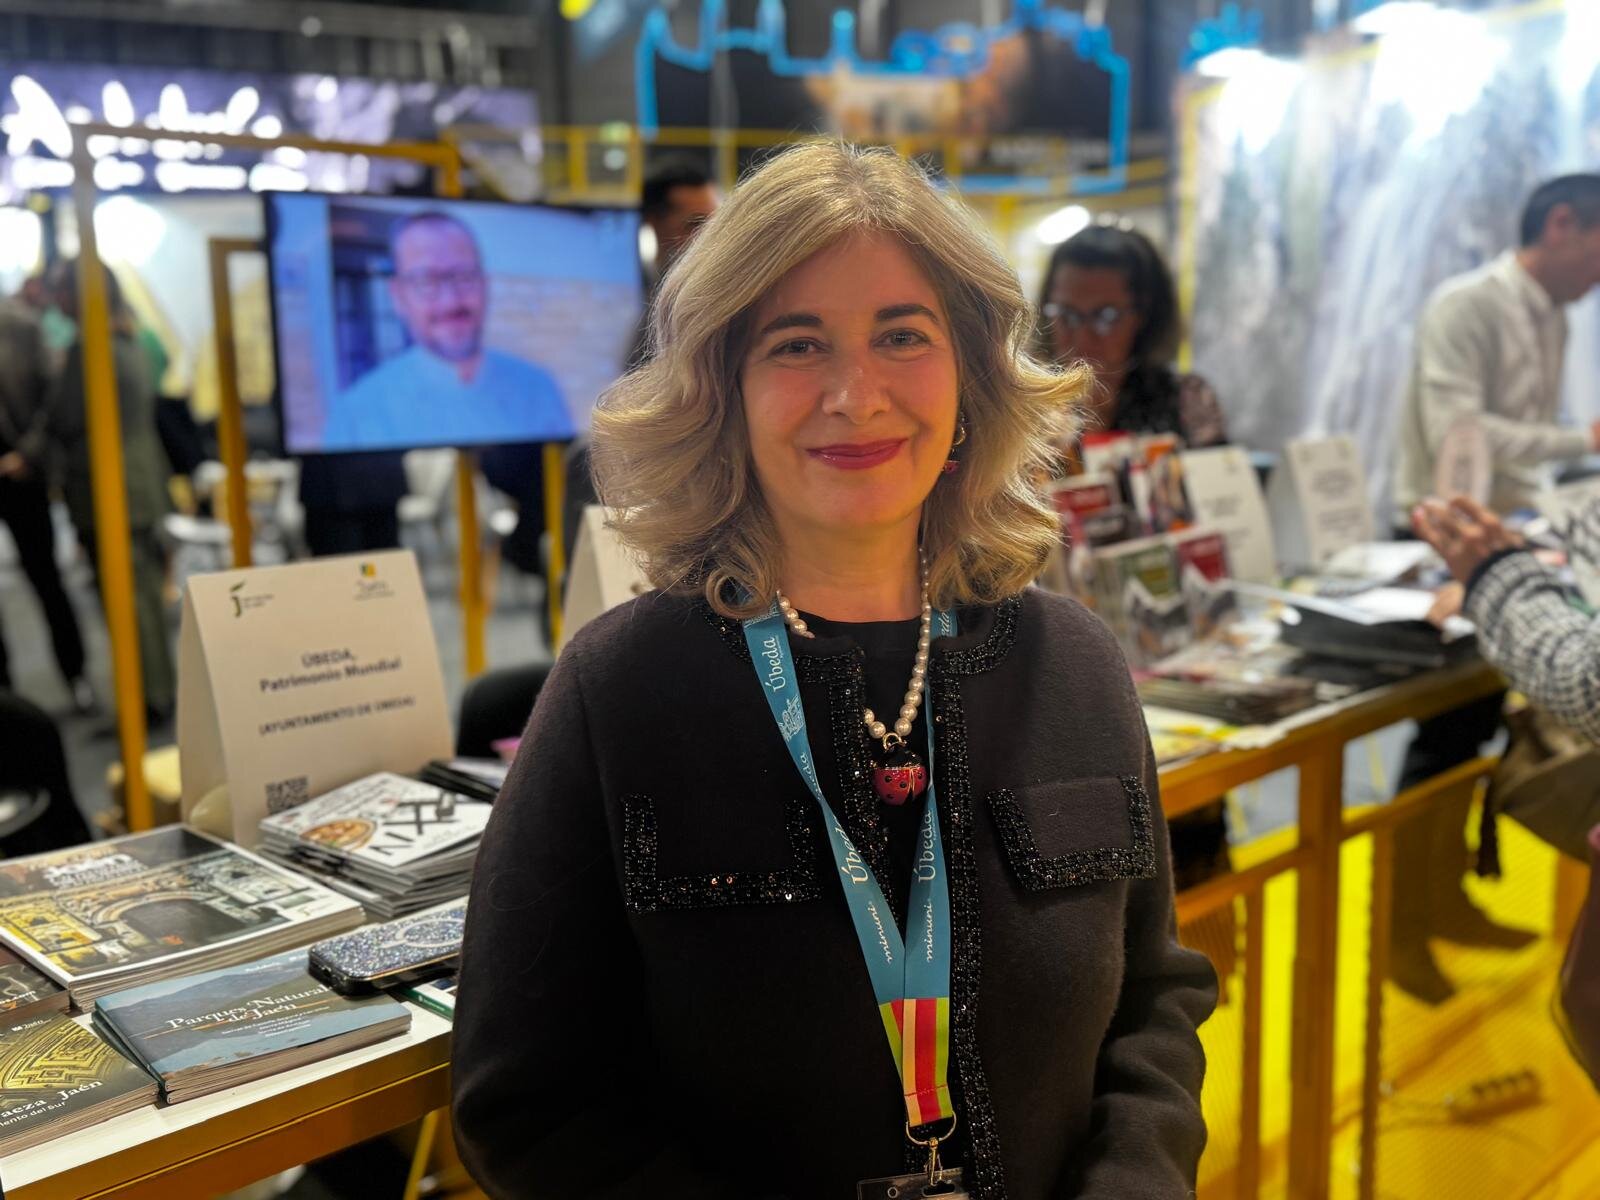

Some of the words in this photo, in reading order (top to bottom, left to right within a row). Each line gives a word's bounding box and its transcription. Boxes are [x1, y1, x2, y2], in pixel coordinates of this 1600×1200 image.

[260, 669, 342, 693] Patrimonio
[345, 658, 402, 679] Mundial
[762, 636, 786, 693] Úbeda
[832, 813, 869, 885] Úbed
[913, 810, 936, 883] Úbeda
[165, 1006, 248, 1029] Parques
[246, 983, 333, 1010] Natural
[228, 1011, 249, 1024] de
[252, 1002, 298, 1021] Jaén
[0, 1098, 48, 1118] aeza
[57, 1079, 104, 1101] Jaén
[0, 1113, 29, 1128] iento
[30, 1107, 47, 1117] del
[48, 1101, 67, 1111] Sur
